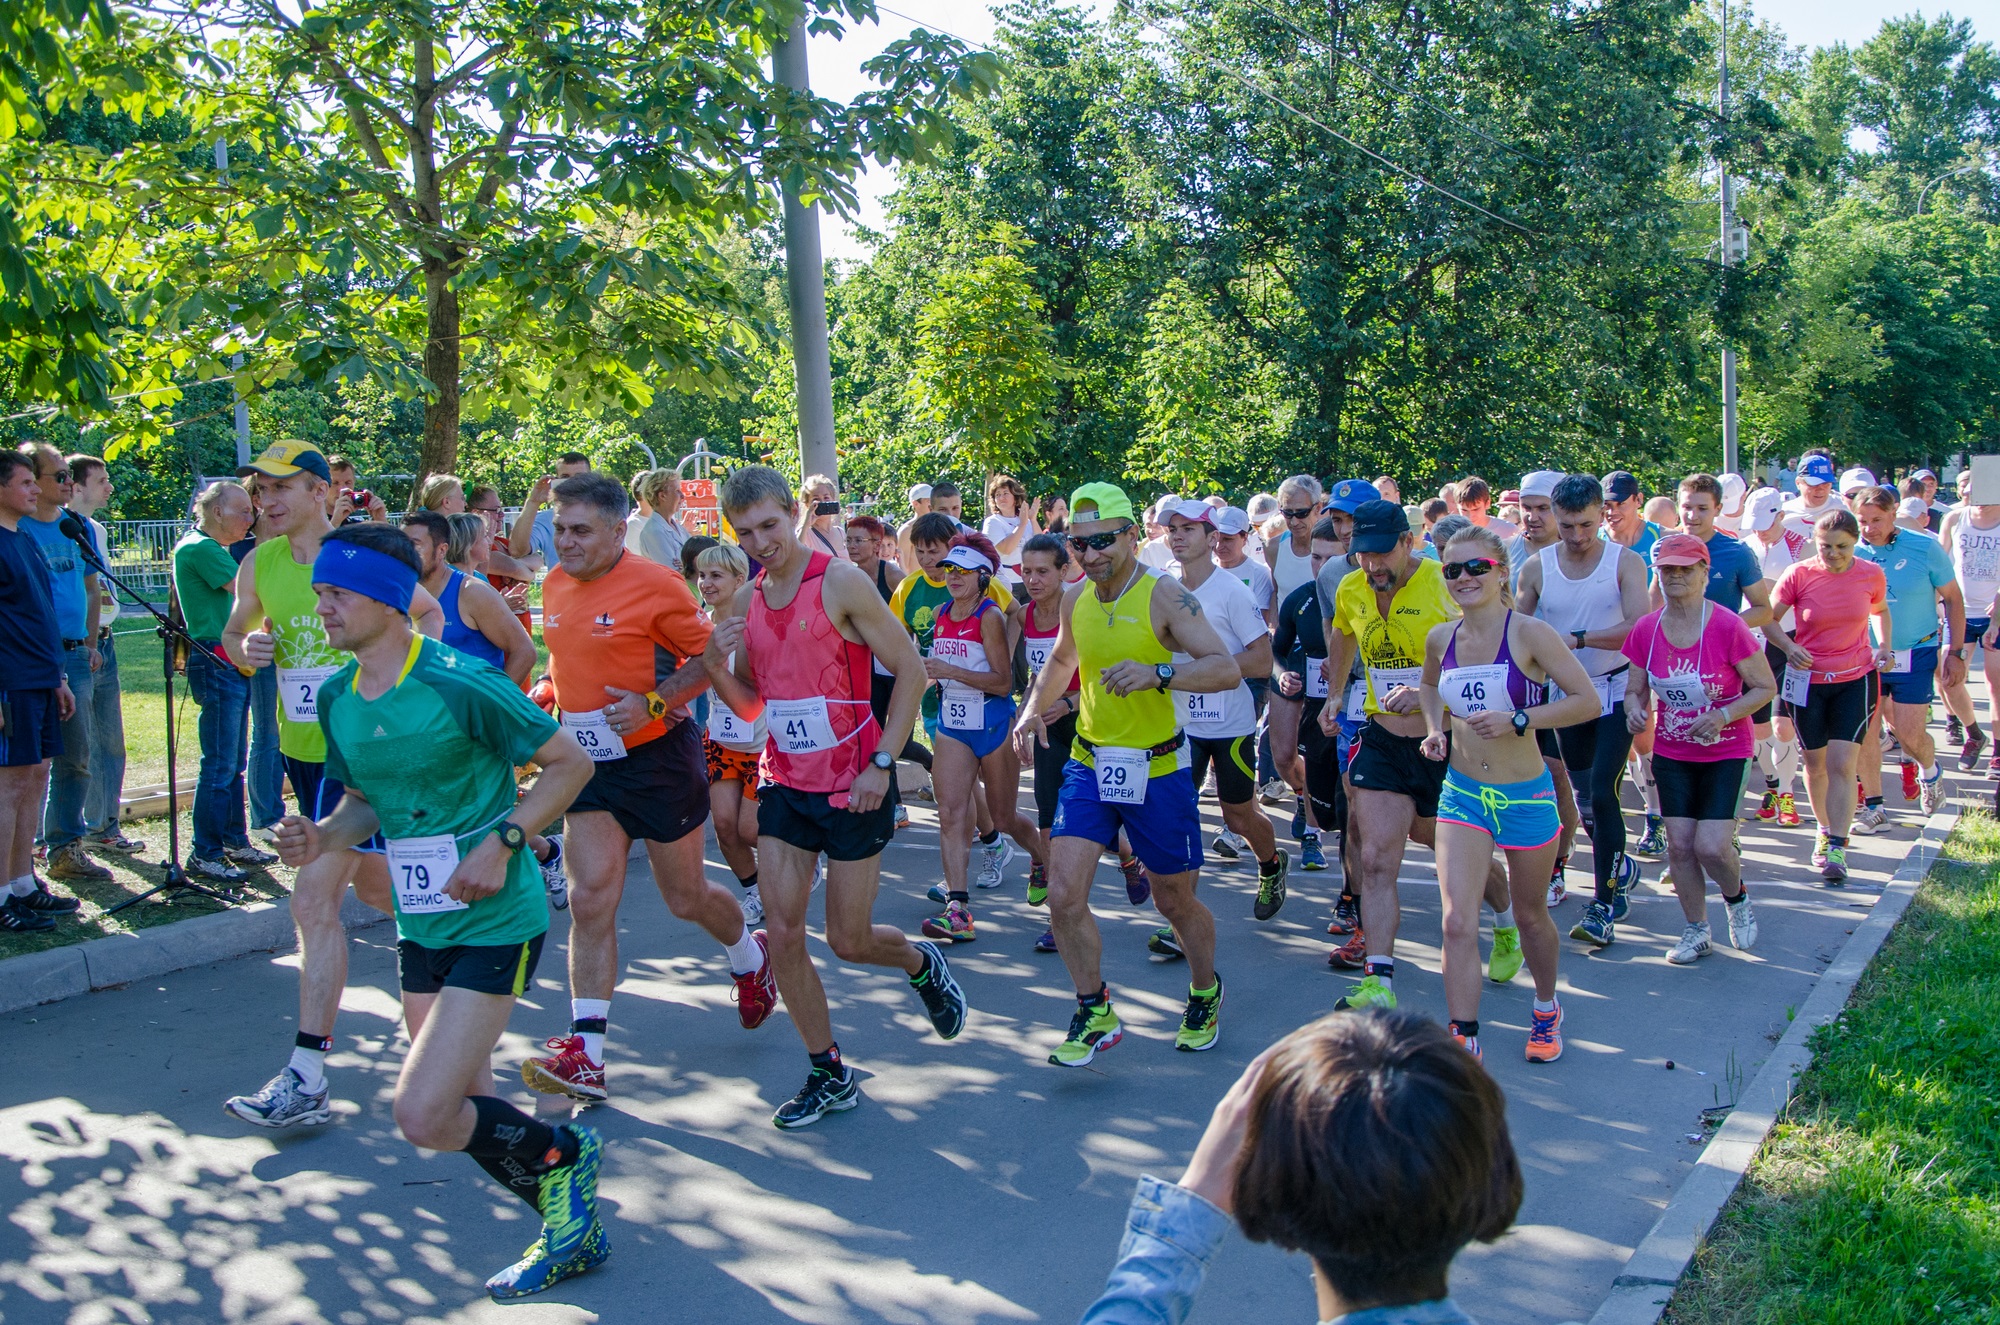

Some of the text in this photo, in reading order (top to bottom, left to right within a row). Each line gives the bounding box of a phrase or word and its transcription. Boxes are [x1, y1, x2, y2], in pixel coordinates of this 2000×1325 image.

[934, 641, 968, 658] RUSSIA
[1031, 650, 1045, 664] 42
[1461, 682, 1486, 701] 46
[1785, 678, 1795, 692] 61
[300, 684, 314, 703] 2
[1666, 690, 1687, 701] 69
[1188, 695, 1205, 709] 81
[1466, 703, 1487, 712] ИРА
[950, 703, 966, 717] 53
[724, 717, 732, 730] 5
[786, 719, 808, 738] 41
[951, 719, 966, 727] ИРА
[576, 730, 599, 747] 63
[720, 731, 739, 739] ИННА
[789, 740, 818, 751] ДИМА
[1101, 766, 1127, 785] 29
[1100, 787, 1135, 799] НДРЕЙ
[401, 865, 430, 890] 79
[402, 893, 444, 908] ДЕНИС
